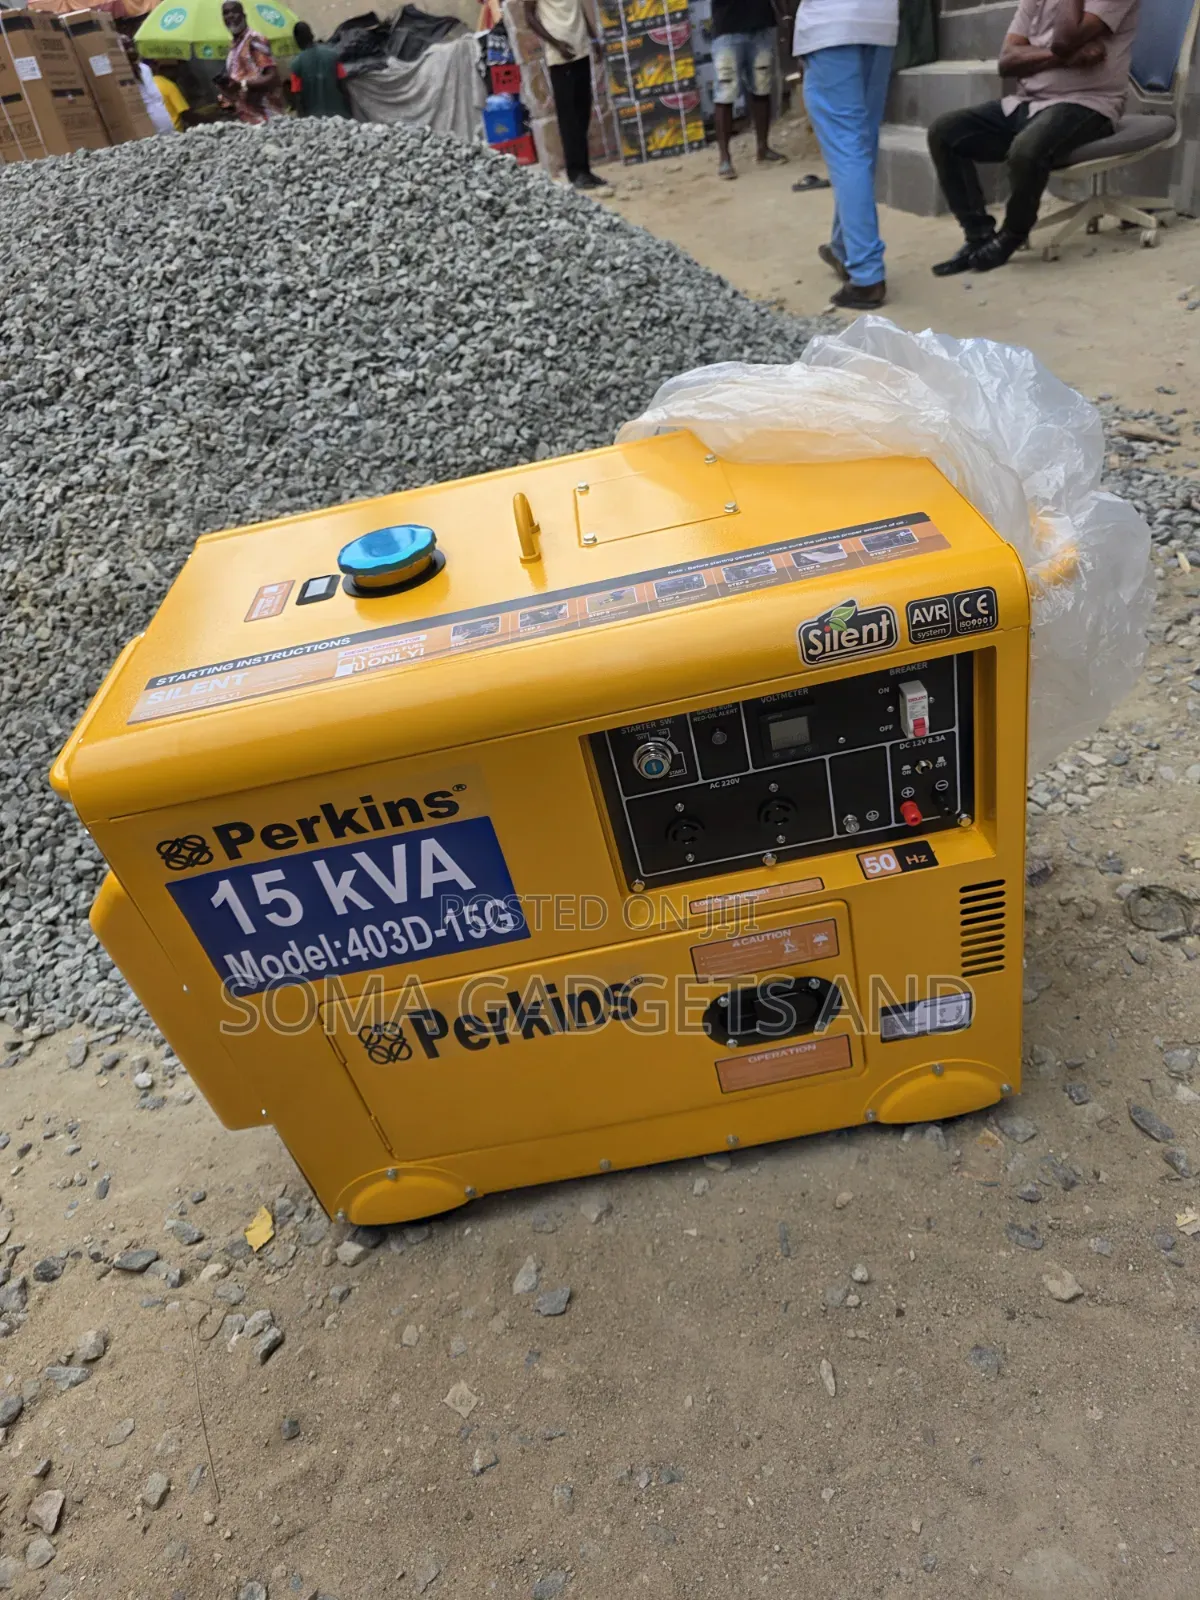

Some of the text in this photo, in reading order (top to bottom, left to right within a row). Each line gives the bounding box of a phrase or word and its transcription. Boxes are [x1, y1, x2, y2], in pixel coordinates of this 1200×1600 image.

[163, 12, 185, 26] glo
[841, 529, 862, 538] proper
[959, 594, 988, 618] CE
[912, 603, 949, 625] AVR
[959, 615, 993, 628] ISO9001
[807, 613, 890, 656] Silent
[917, 627, 947, 640] system
[401, 643, 424, 651] FUEL
[155, 662, 234, 686] STARTING
[236, 637, 351, 667] INSTRUCTIONS
[367, 647, 425, 666] ONLY!
[889, 662, 928, 676] BREAKER
[146, 672, 249, 705] SILENT
[760, 688, 809, 703] VOLTMETER
[878, 687, 890, 695] ON
[718, 708, 738, 717] ALERT
[621, 717, 674, 735] STARTER SW.
[879, 724, 894, 732] OFF
[899, 742, 911, 750] DC
[912, 738, 927, 747] 12V
[669, 768, 685, 776] START
[709, 777, 740, 790] AC 220V
[863, 852, 929, 874] 50 Hz
[210, 837, 477, 935] 15 kVA
[739, 929, 792, 947] CAUTION
[747, 1043, 817, 1064] OPERATION
